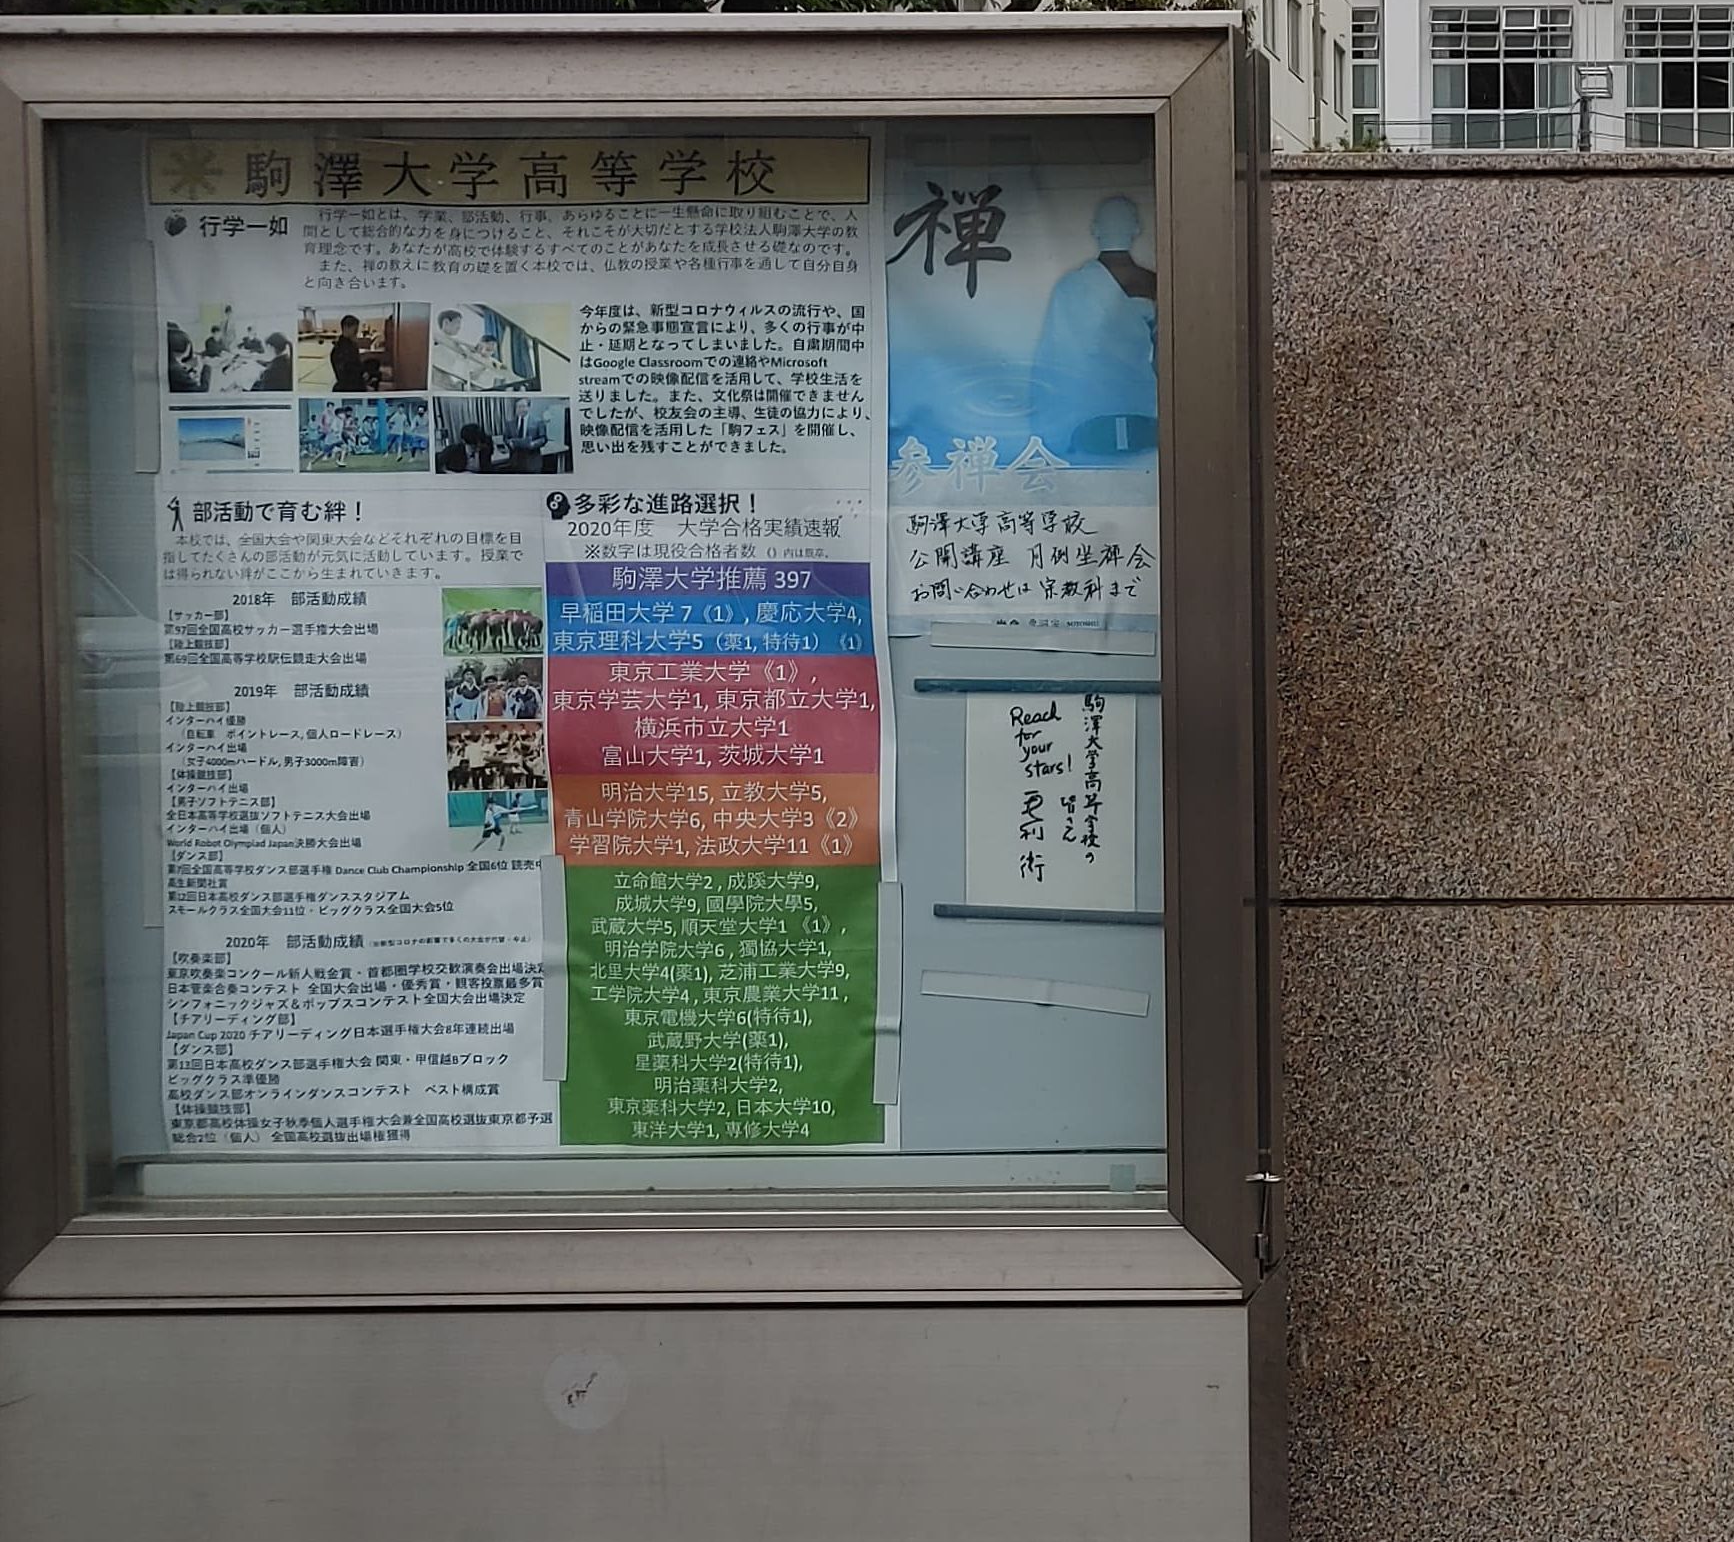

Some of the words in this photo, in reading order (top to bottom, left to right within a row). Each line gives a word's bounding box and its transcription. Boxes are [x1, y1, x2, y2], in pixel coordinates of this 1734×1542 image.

[243, 147, 780, 200] 駒澤大学高等学校
[199, 215, 289, 238] 行学一如
[886, 181, 1013, 299] 禅
[303, 275, 408, 290] と向き合います。
[580, 440, 788, 454] 思い出を残すことができました。
[890, 435, 1071, 496] 参禅会
[193, 500, 362, 523] 部活動で育む絆！
[574, 492, 757, 515] 多彩な進路選択！
[567, 517, 654, 538] 2020年度
[678, 517, 841, 539] 大学合格実績速報
[908, 542, 1010, 570] 公開講座
[612, 566, 767, 591] 駒澤大学推薦
[774, 569, 812, 589] 397
[232, 592, 276, 607] 2018年
[291, 591, 368, 607] 部活動成績
[560, 602, 675, 625] 早稲田大学
[755, 601, 863, 626] 慶応大学4,
[234, 684, 278, 698] 2019年
[293, 683, 370, 699] 部活動成績
[552, 689, 709, 712] 東京学芸大学1,
[716, 688, 876, 712] 東京都立大学1,
[1009, 700, 1062, 727] Reach
[635, 716, 789, 739] 横浜市立大学1
[1015, 727, 1043, 747] for
[601, 744, 713, 768] 富山大学1,
[718, 743, 825, 768] 茨城大学1
[1019, 741, 1054, 763] your
[1024, 753, 1072, 778] stars!
[601, 781, 715, 805] 明治大学15,
[720, 780, 828, 804] 立教大学5,
[563, 808, 707, 832] 青山学院大学6,
[194, 839, 222, 849] Robot
[223, 838, 266, 851] Olympiad
[569, 835, 690, 858] 学習院大学1,
[335, 865, 364, 875] Dance
[367, 864, 389, 875] Club
[391, 862, 465, 876] Championship
[727, 870, 820, 891] 成蹊大学9,
[615, 895, 701, 915] 成城大学9,
[706, 894, 818, 914] 國學院大學5,
[590, 917, 678, 937] 武蔵大学5,
[225, 935, 269, 949] 2020年
[286, 934, 365, 949] 部活動成績
[738, 937, 832, 958] 獨協大学1,
[718, 960, 850, 982] 芝浦工業大学9,
[624, 1007, 813, 1028] 東京電機大学6(特待1),
[220, 1029, 246, 1041] 2020
[647, 1030, 789, 1051] 武蔵野大学(薬1),
[655, 1076, 783, 1095] 明治薬科大学2,
[608, 1098, 731, 1118] 東京薬科大学2,
[737, 1097, 837, 1117] 日本大学10,
[631, 1120, 720, 1140] 東洋大学1,
[725, 1119, 811, 1140] 専修大学4
